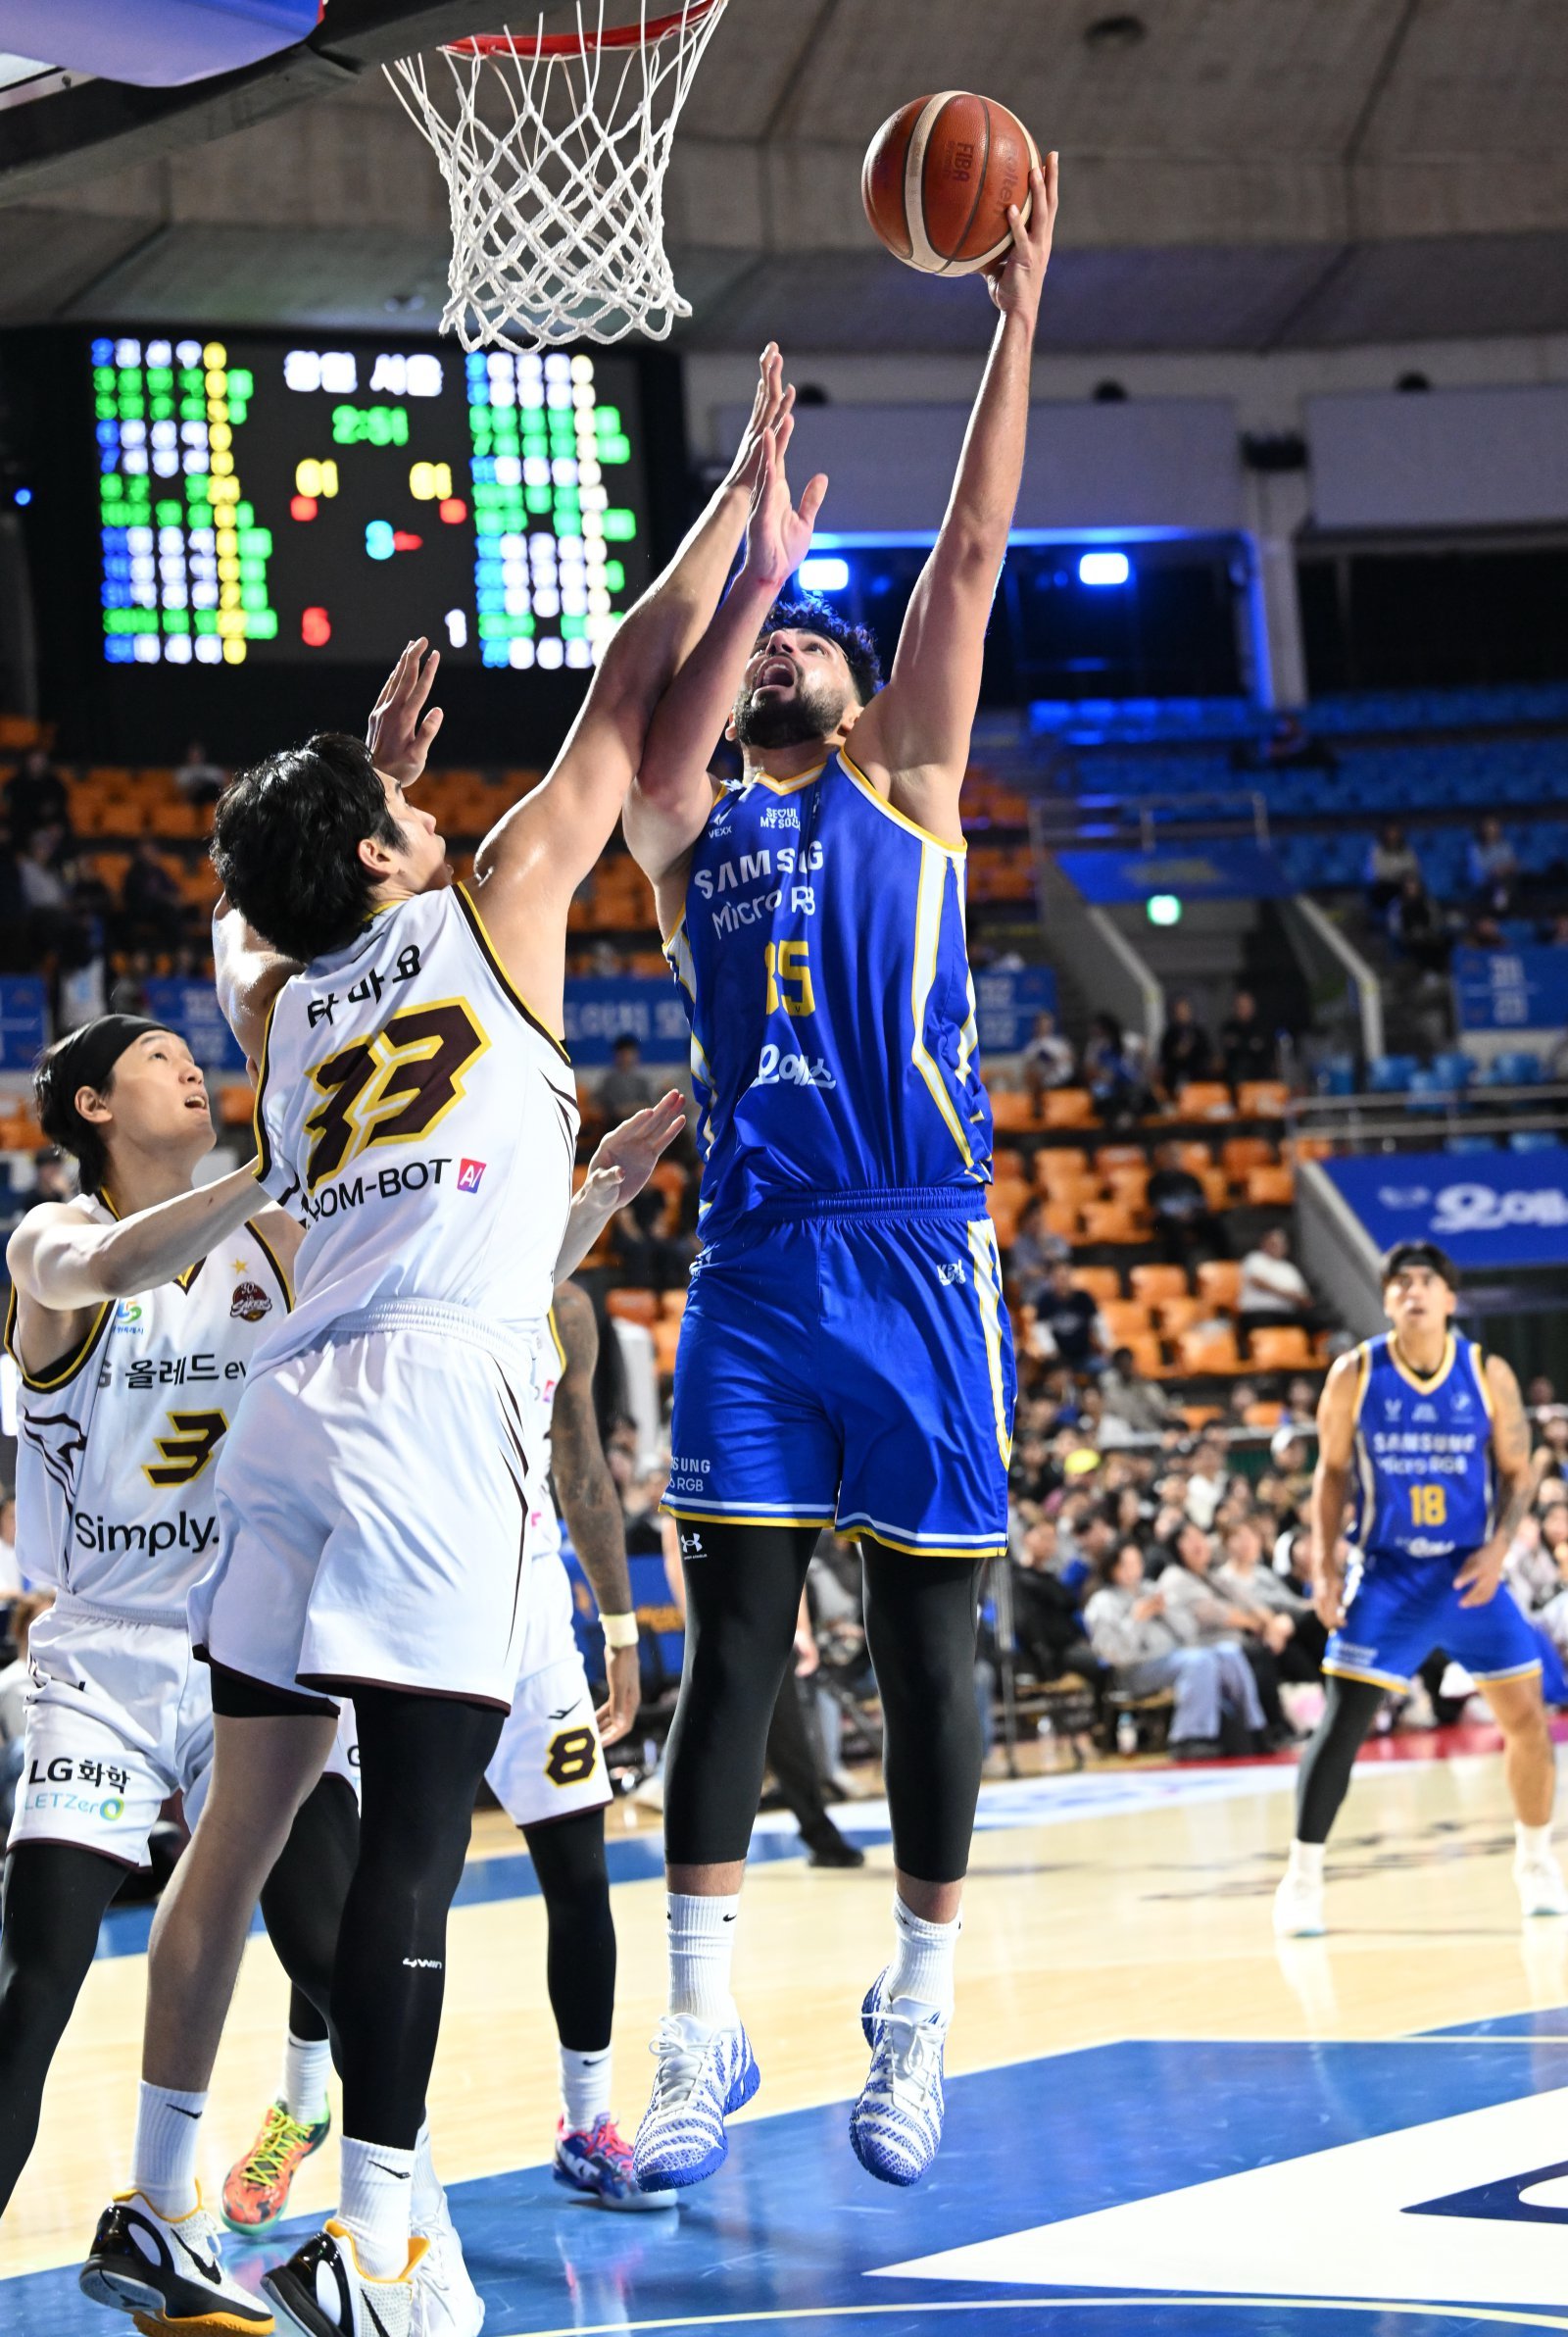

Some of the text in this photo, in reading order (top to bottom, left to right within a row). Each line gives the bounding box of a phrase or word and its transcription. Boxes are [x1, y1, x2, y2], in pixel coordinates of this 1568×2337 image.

[709, 825, 732, 839] VEXX
[711, 888, 783, 941] Micro
[307, 944, 421, 1028] 타마요
[124, 1354, 220, 1390] 올레드
[140, 1408, 230, 1489] 3
[676, 1476, 705, 1492] RGB
[1409, 1484, 1446, 1527] 18
[74, 1510, 220, 1558] Simply.
[28, 1757, 130, 1795] LG 화학
[544, 1725, 598, 1789] 8
